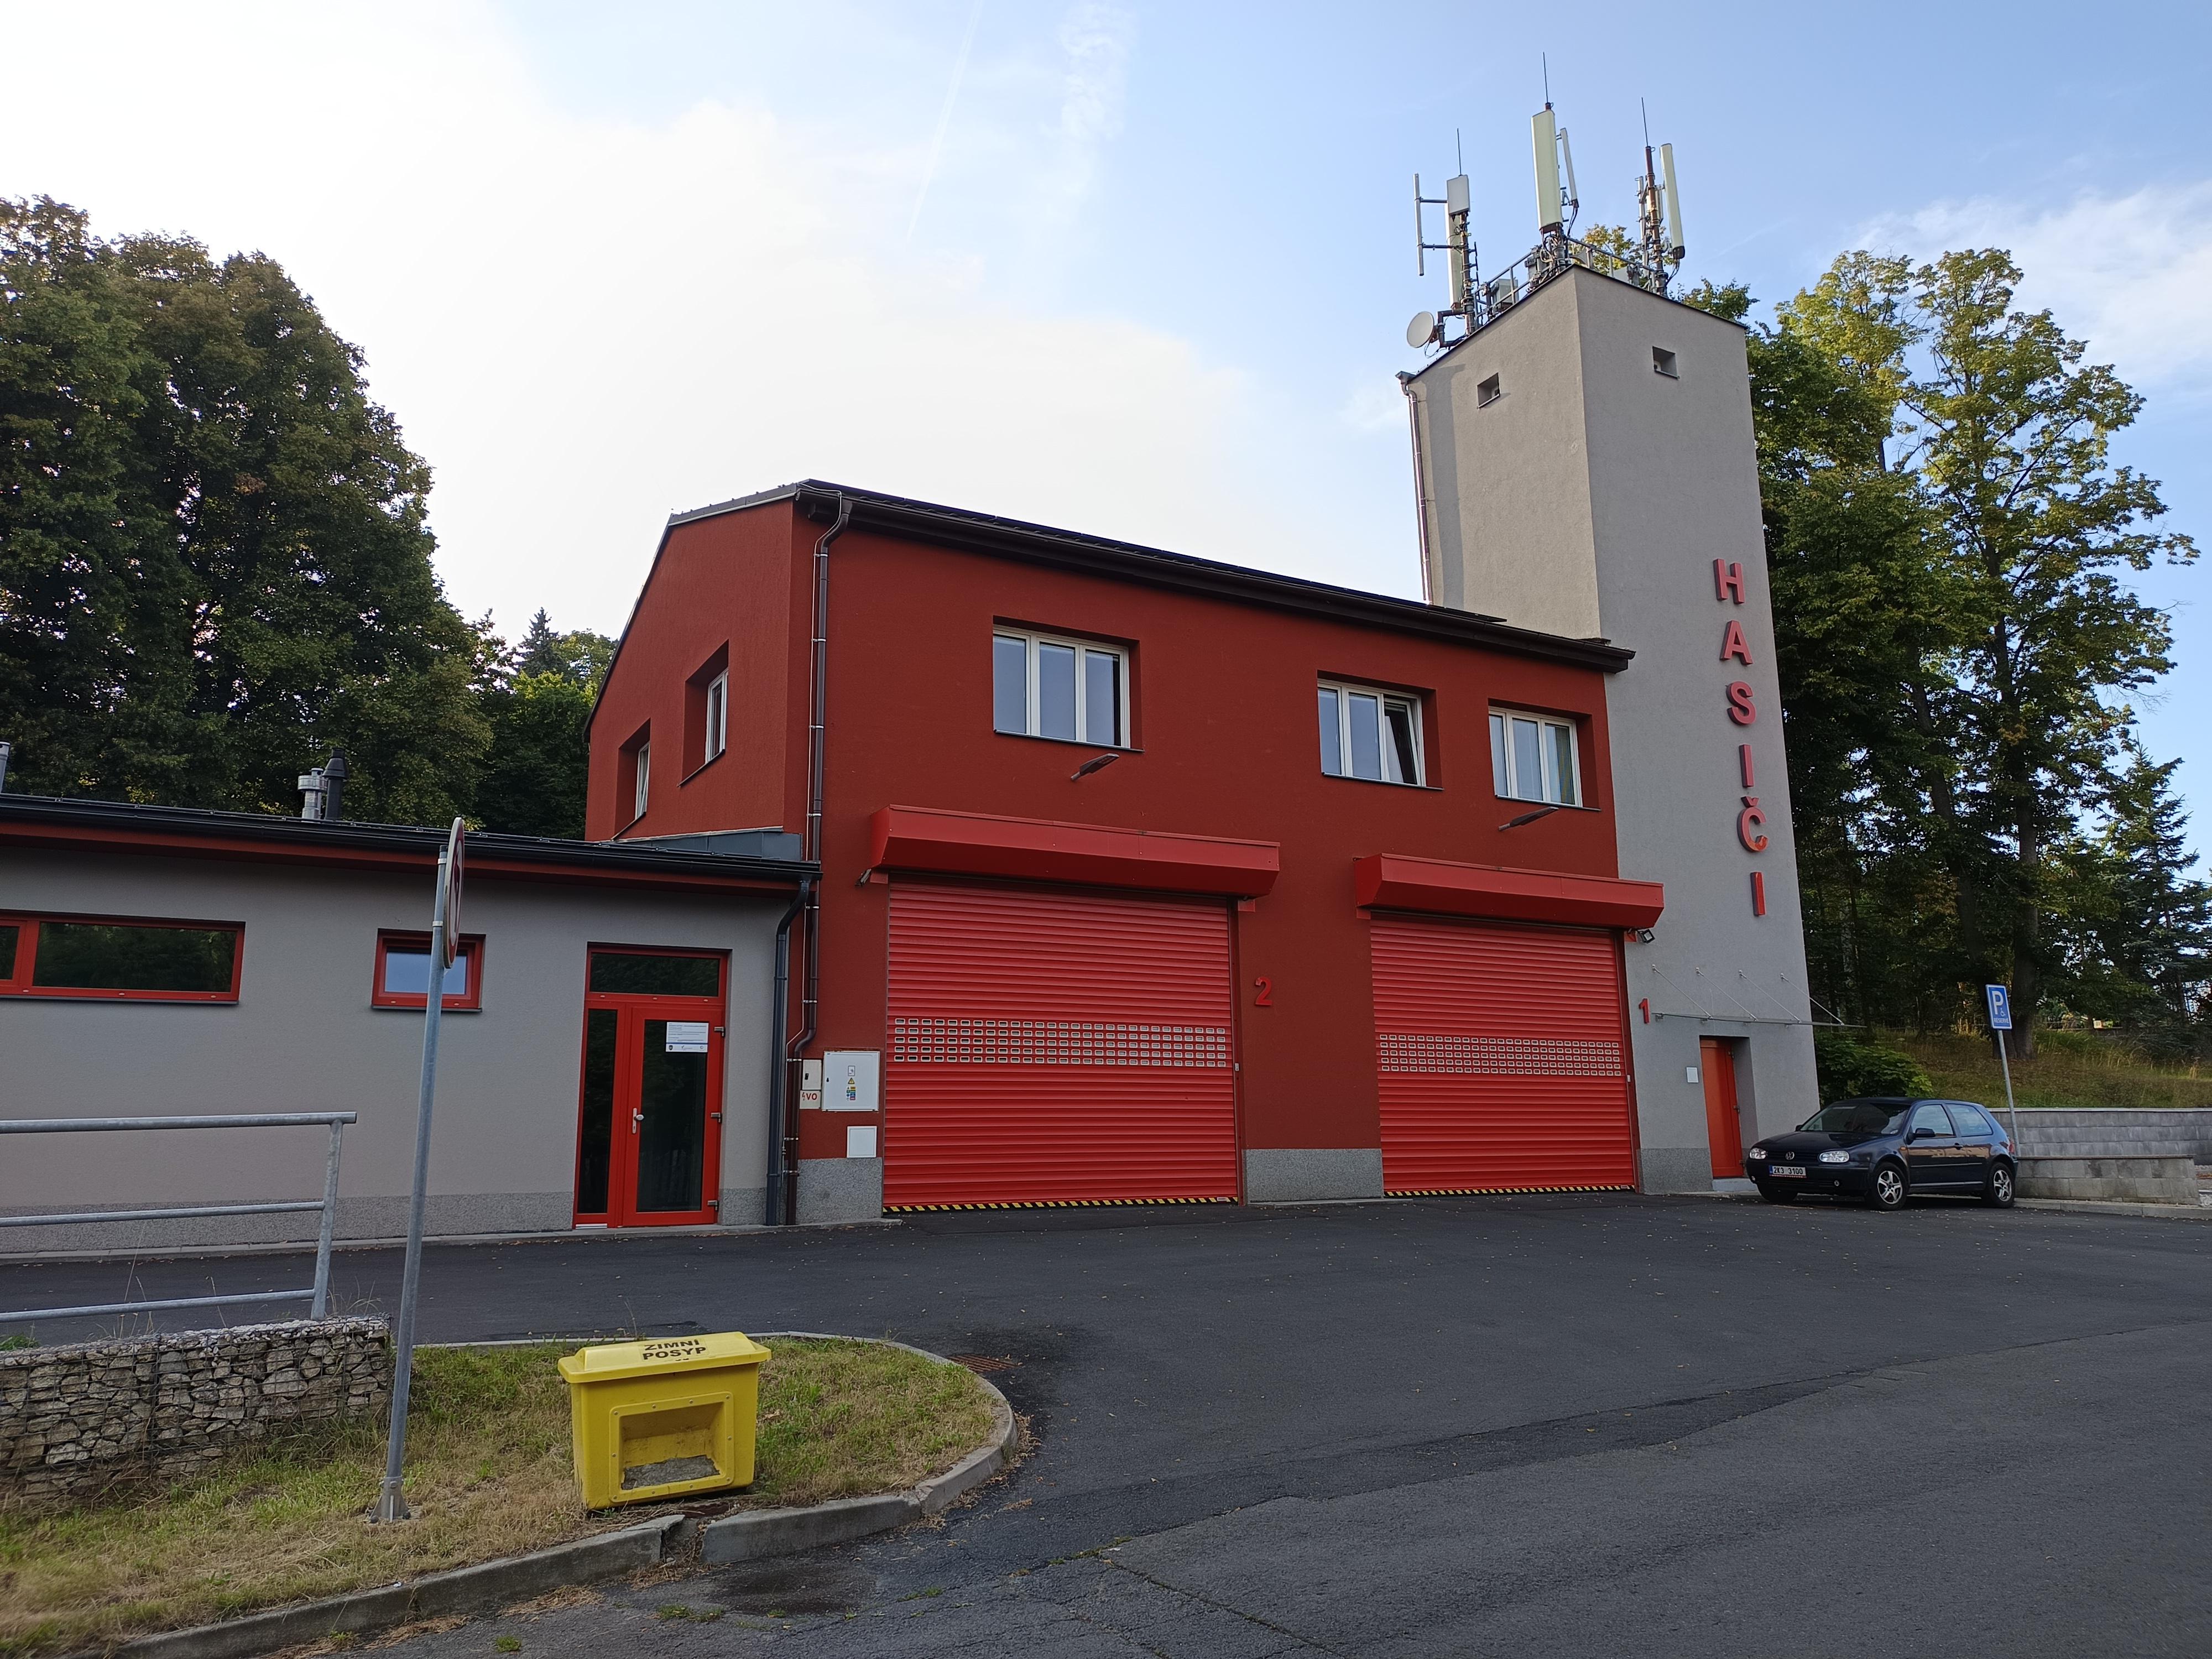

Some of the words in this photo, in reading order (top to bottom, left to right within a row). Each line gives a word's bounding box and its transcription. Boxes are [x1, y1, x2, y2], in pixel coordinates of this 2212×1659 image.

[1713, 558, 1768, 916] HASIČI
[1254, 976, 1274, 1006] 2
[1992, 990, 2004, 1015] P
[1639, 998, 1650, 1024] 1
[643, 1347, 706, 1360] POSYP
[644, 1339, 700, 1350] ZIMNÍ
